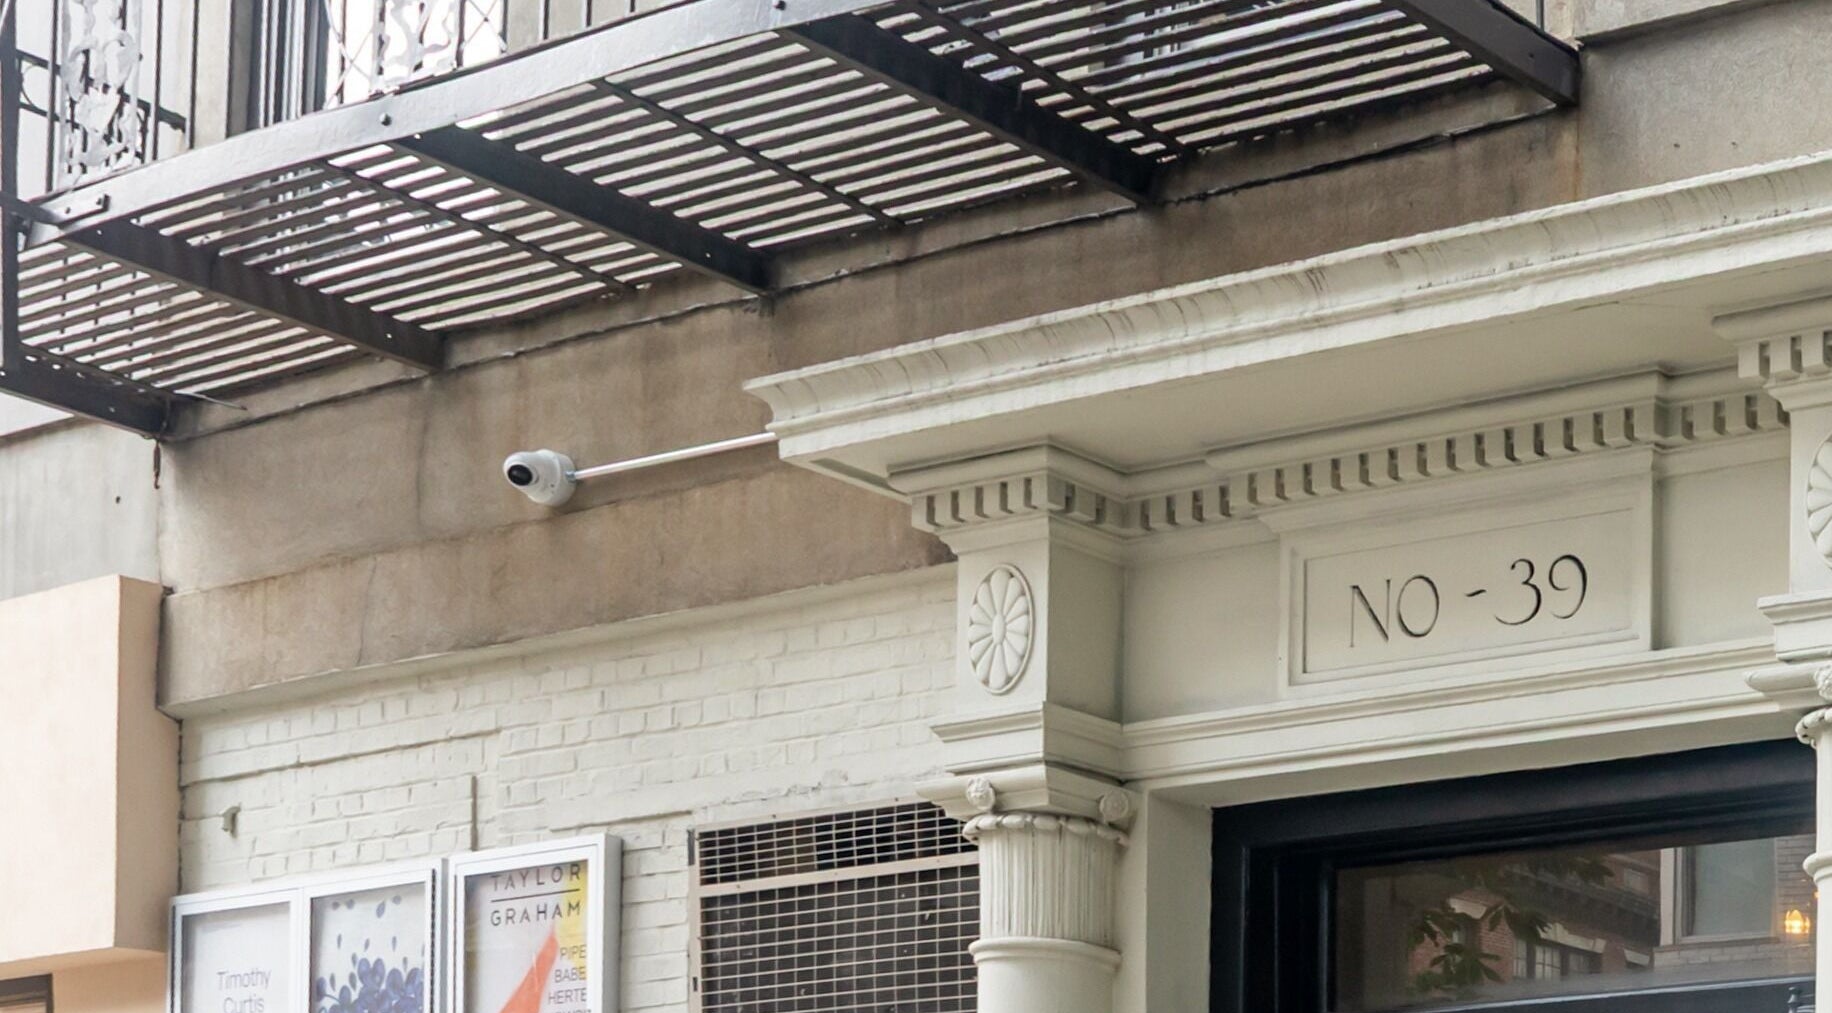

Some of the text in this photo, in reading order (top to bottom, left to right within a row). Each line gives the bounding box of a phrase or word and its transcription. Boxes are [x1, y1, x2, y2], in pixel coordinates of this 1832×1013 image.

[1350, 574, 1440, 648] NO
[490, 863, 581, 891] TAYLOR
[490, 901, 581, 926] GRAHAM
[217, 967, 271, 990] Timothy
